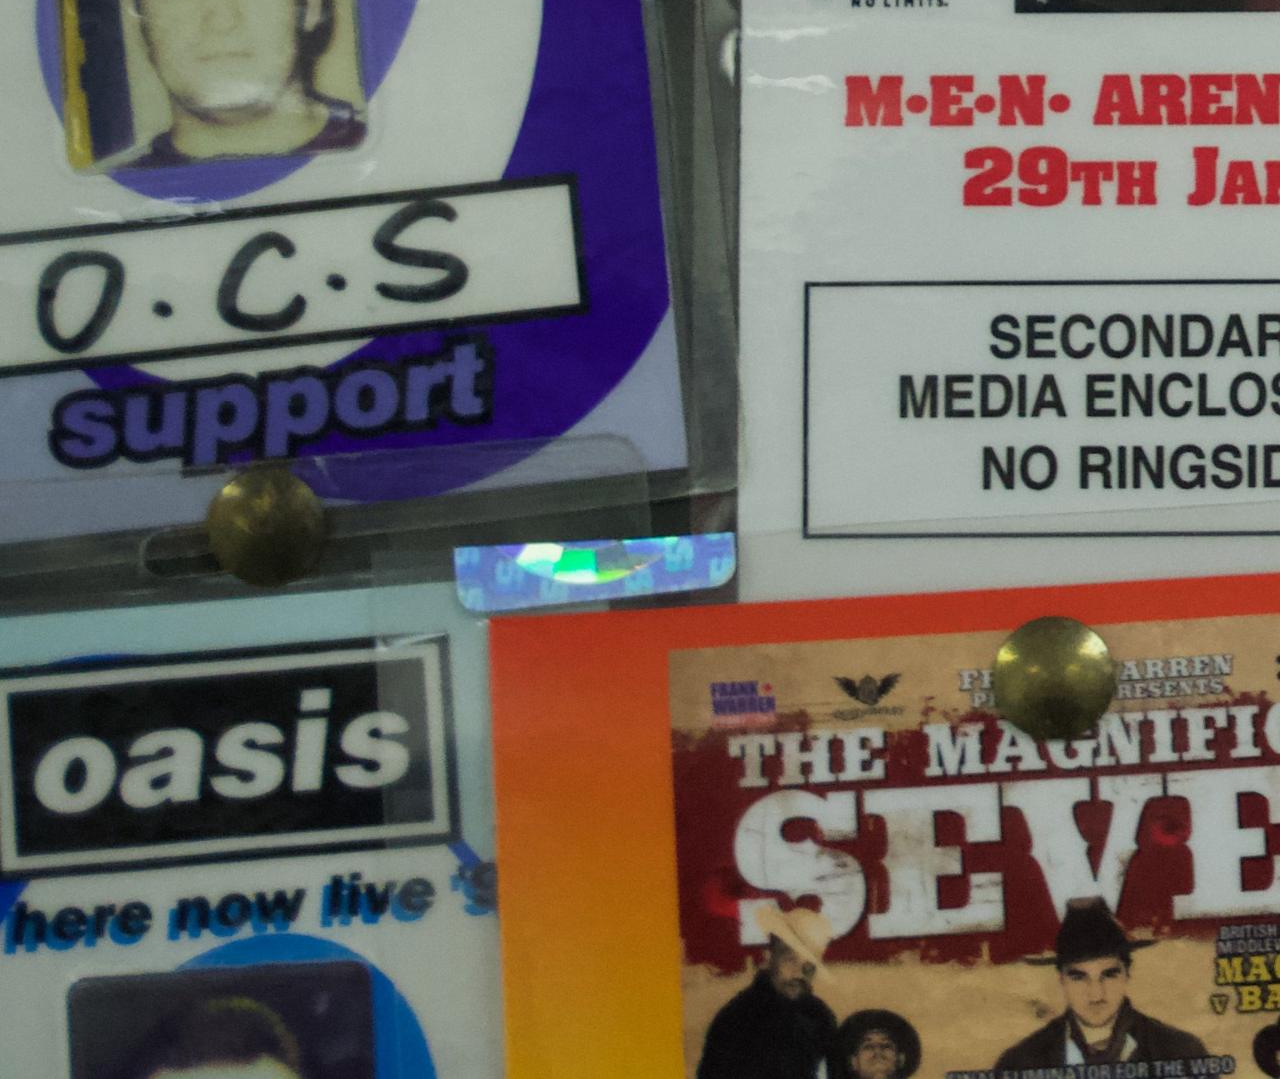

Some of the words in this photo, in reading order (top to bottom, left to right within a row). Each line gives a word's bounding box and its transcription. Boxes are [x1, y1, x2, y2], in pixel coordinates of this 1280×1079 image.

[50, 335, 490, 470] support
[898, 375, 1067, 419] MEDIA
[981, 447, 1058, 492] NO
[1116, 679, 1224, 700] RESENTS
[1120, 654, 1233, 681] ARREN
[34, 687, 409, 814] oasis
[729, 728, 889, 788] THE
[8, 900, 152, 953] here
[170, 884, 305, 939] now
[322, 873, 435, 927] live
[1220, 923, 1276, 940] BRITISH
